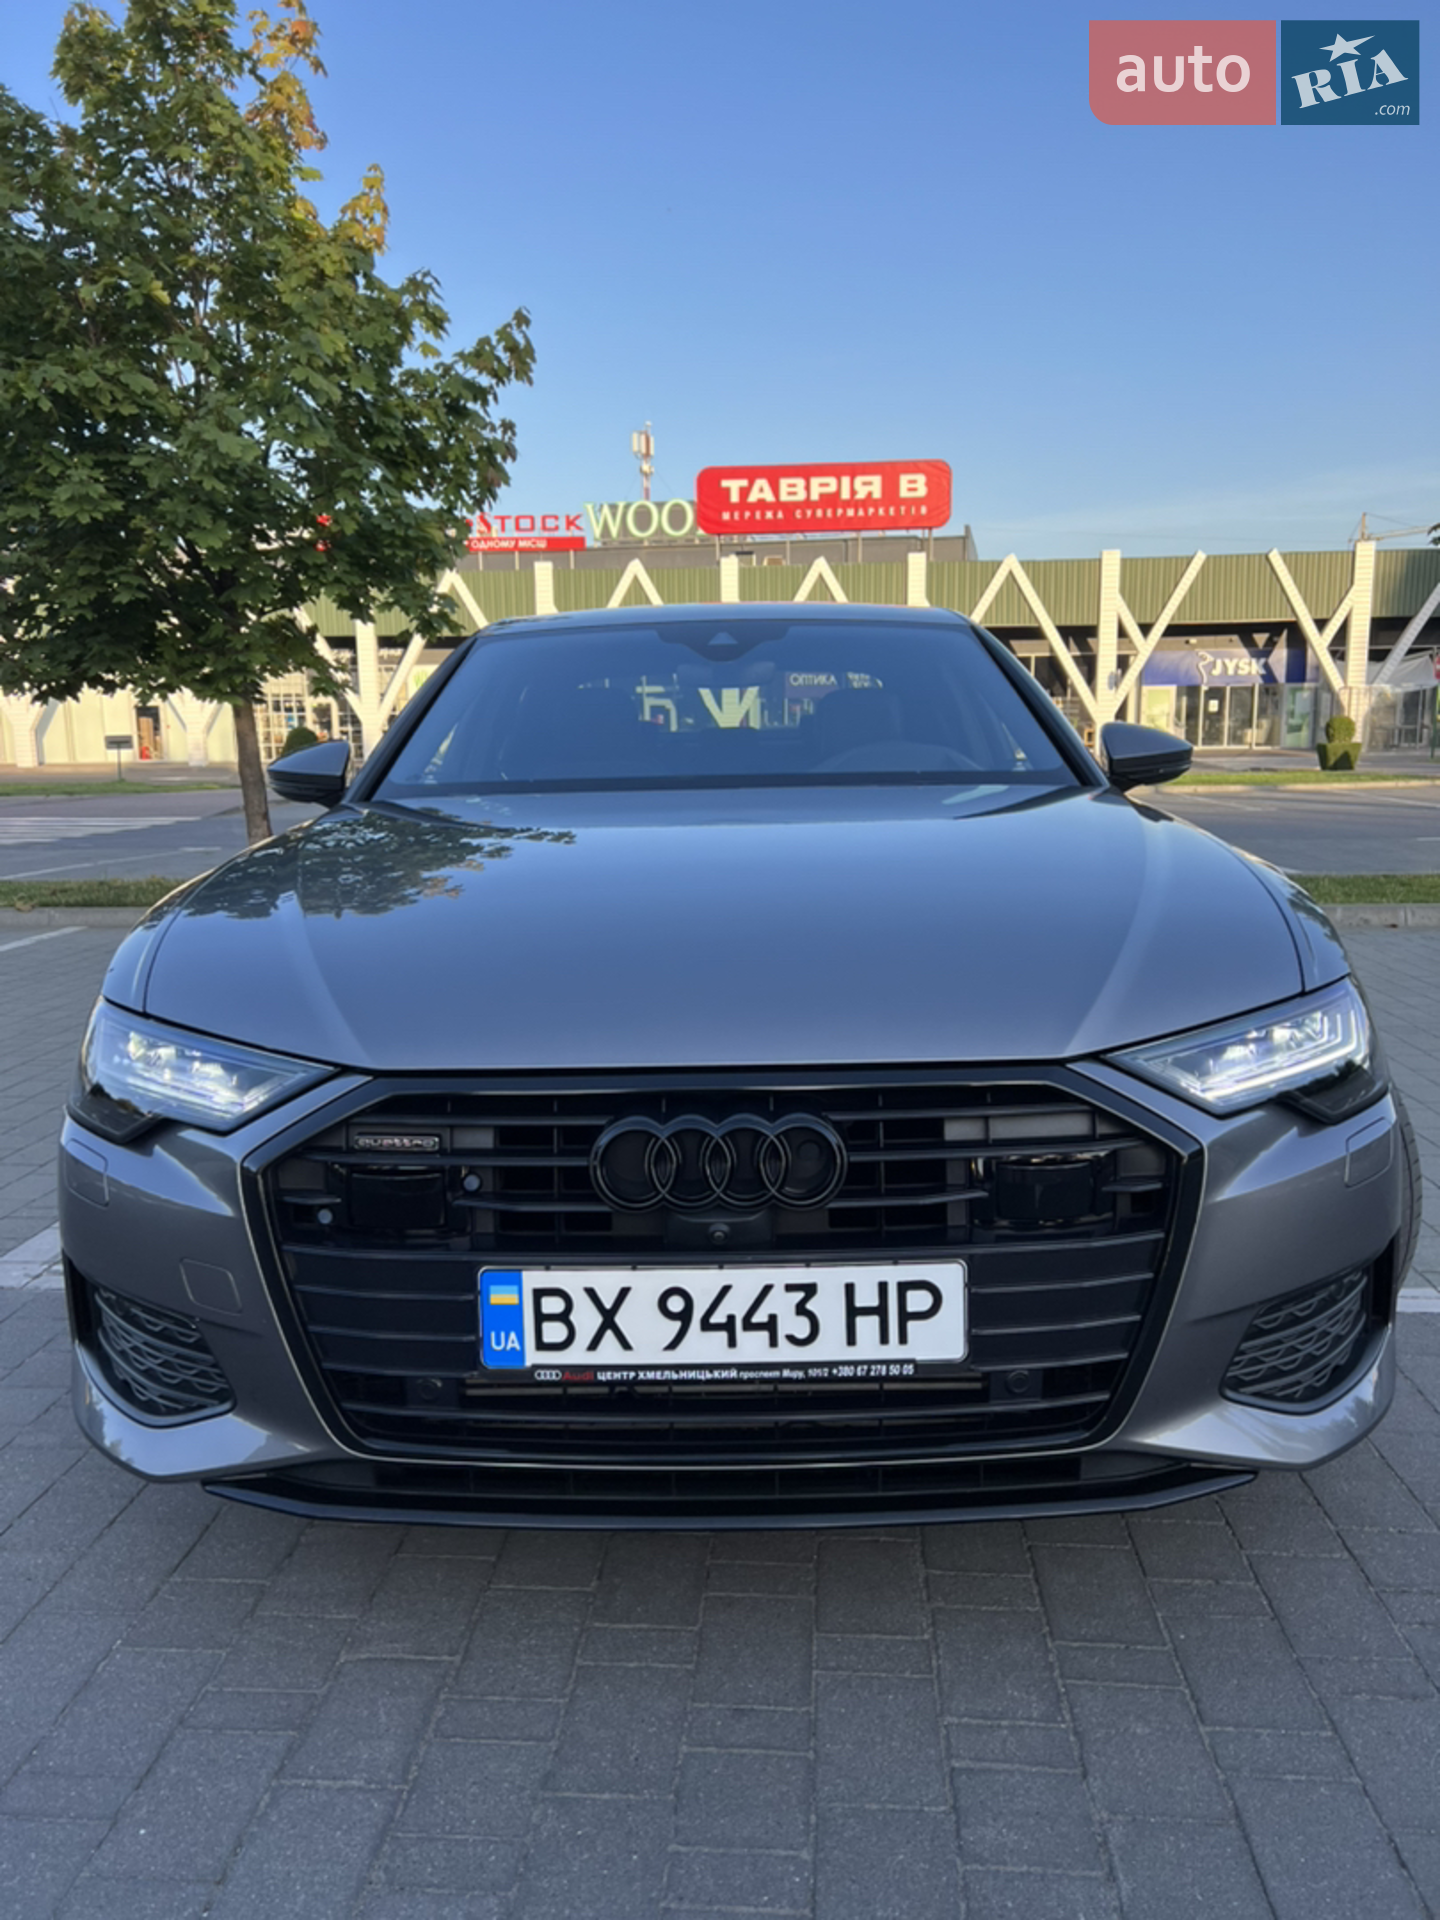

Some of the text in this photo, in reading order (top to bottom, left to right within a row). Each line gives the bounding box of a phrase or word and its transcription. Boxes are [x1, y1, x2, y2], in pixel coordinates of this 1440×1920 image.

[720, 473, 928, 503] ТАВРІЯ В
[584, 500, 709, 540] WOO
[721, 505, 928, 521] МЕРЕЖА СУПЕРМАРКЕТІВ
[1210, 657, 1267, 676] JYSK
[532, 1279, 944, 1352] BX 9443 HP
[490, 1331, 521, 1351] UA
[597, 1371, 636, 1381] ЦЕНТР
[638, 1368, 738, 1380] ХМЕЛЬНИЦЬКИЙ
